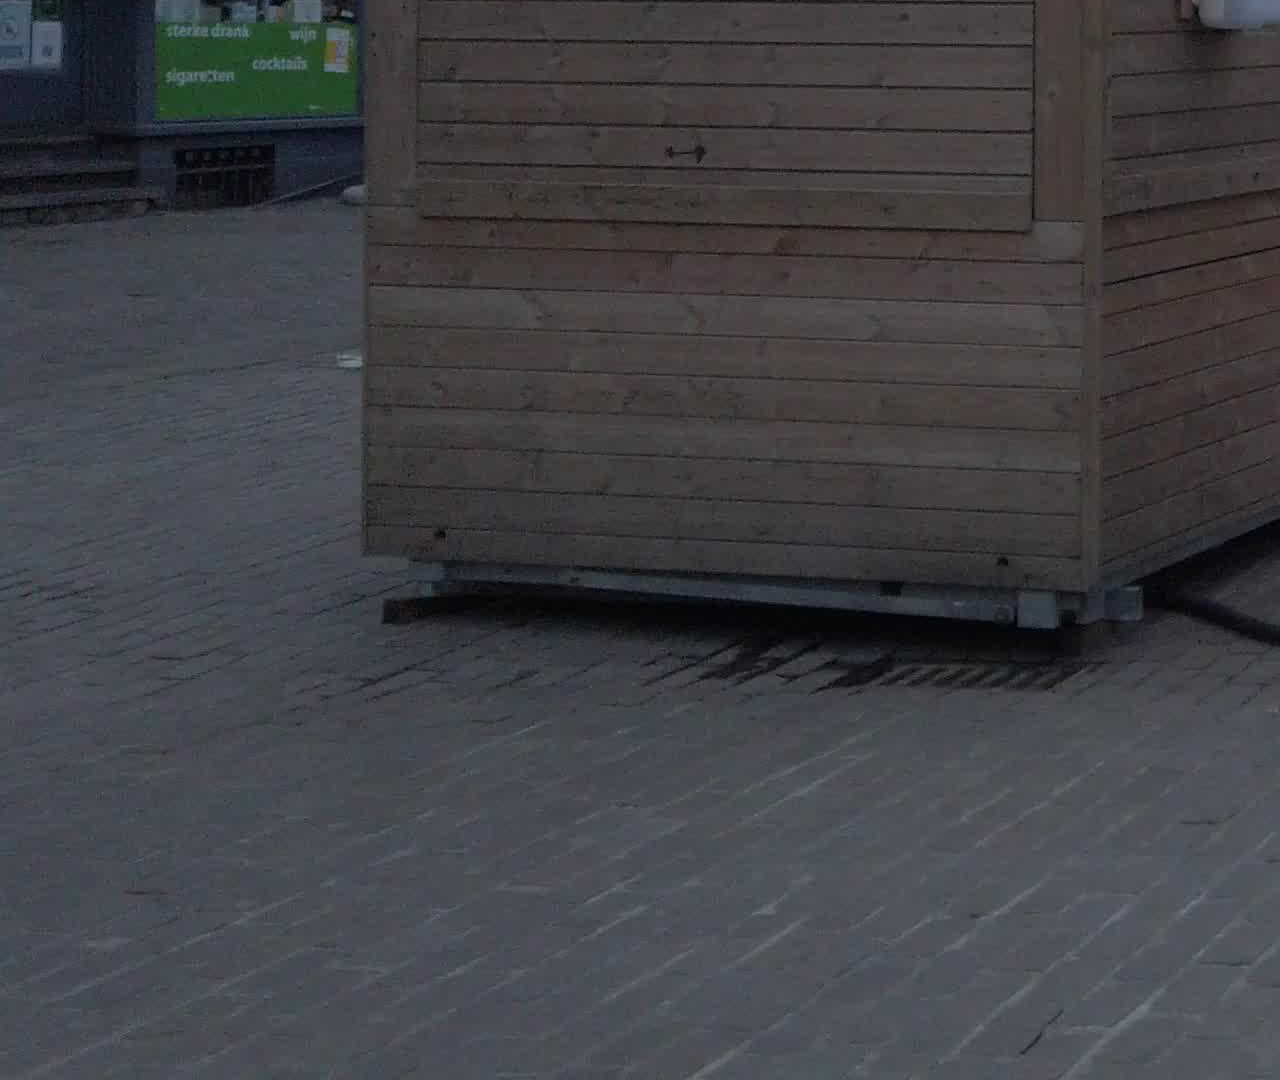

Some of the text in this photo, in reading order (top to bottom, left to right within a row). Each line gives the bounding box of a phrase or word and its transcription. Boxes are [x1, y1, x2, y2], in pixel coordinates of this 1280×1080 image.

[166, 23, 250, 39] sterke drank
[289, 26, 318, 44] wijn
[252, 55, 308, 72] cocktails
[165, 68, 236, 87] sigaretten
